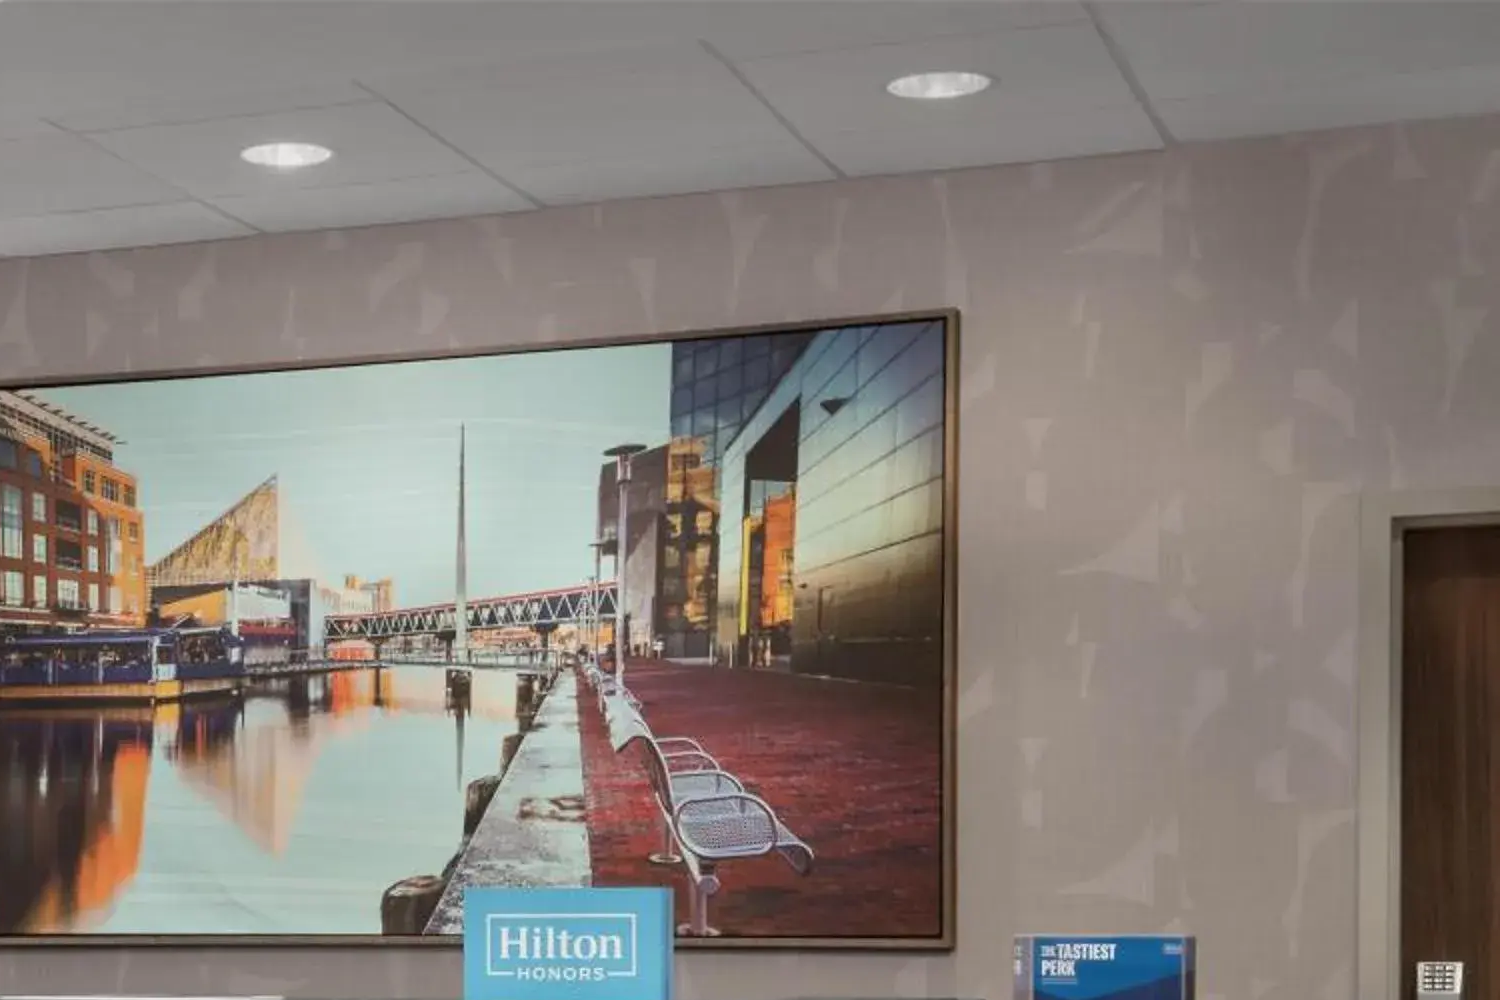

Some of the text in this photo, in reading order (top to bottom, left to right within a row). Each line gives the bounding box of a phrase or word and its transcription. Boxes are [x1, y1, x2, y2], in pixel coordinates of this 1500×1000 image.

[500, 926, 623, 959] Hilton
[1056, 943, 1117, 960] TASTIEST
[517, 967, 606, 981] HONORS
[1041, 960, 1076, 976] PERK
